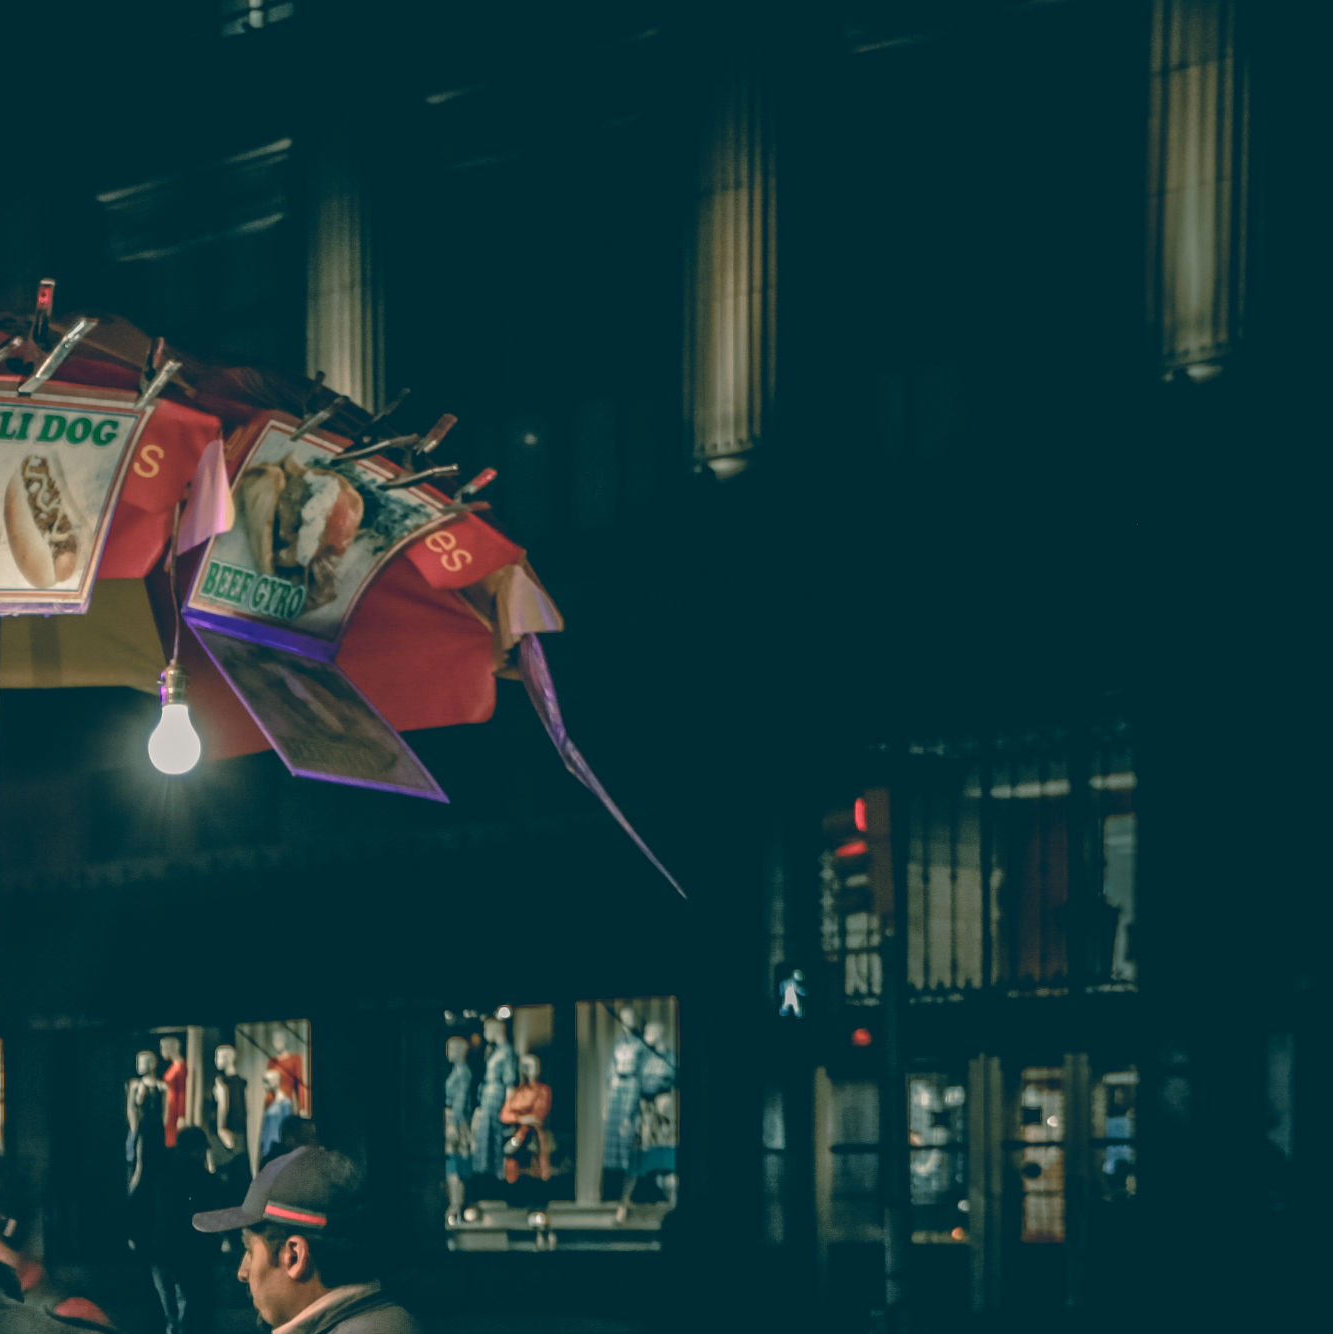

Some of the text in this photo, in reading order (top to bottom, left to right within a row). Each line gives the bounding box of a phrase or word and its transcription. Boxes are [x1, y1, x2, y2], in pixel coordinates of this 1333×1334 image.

[37, 414, 119, 446] DOG
[200, 562, 306, 622] BEEF GYRO
